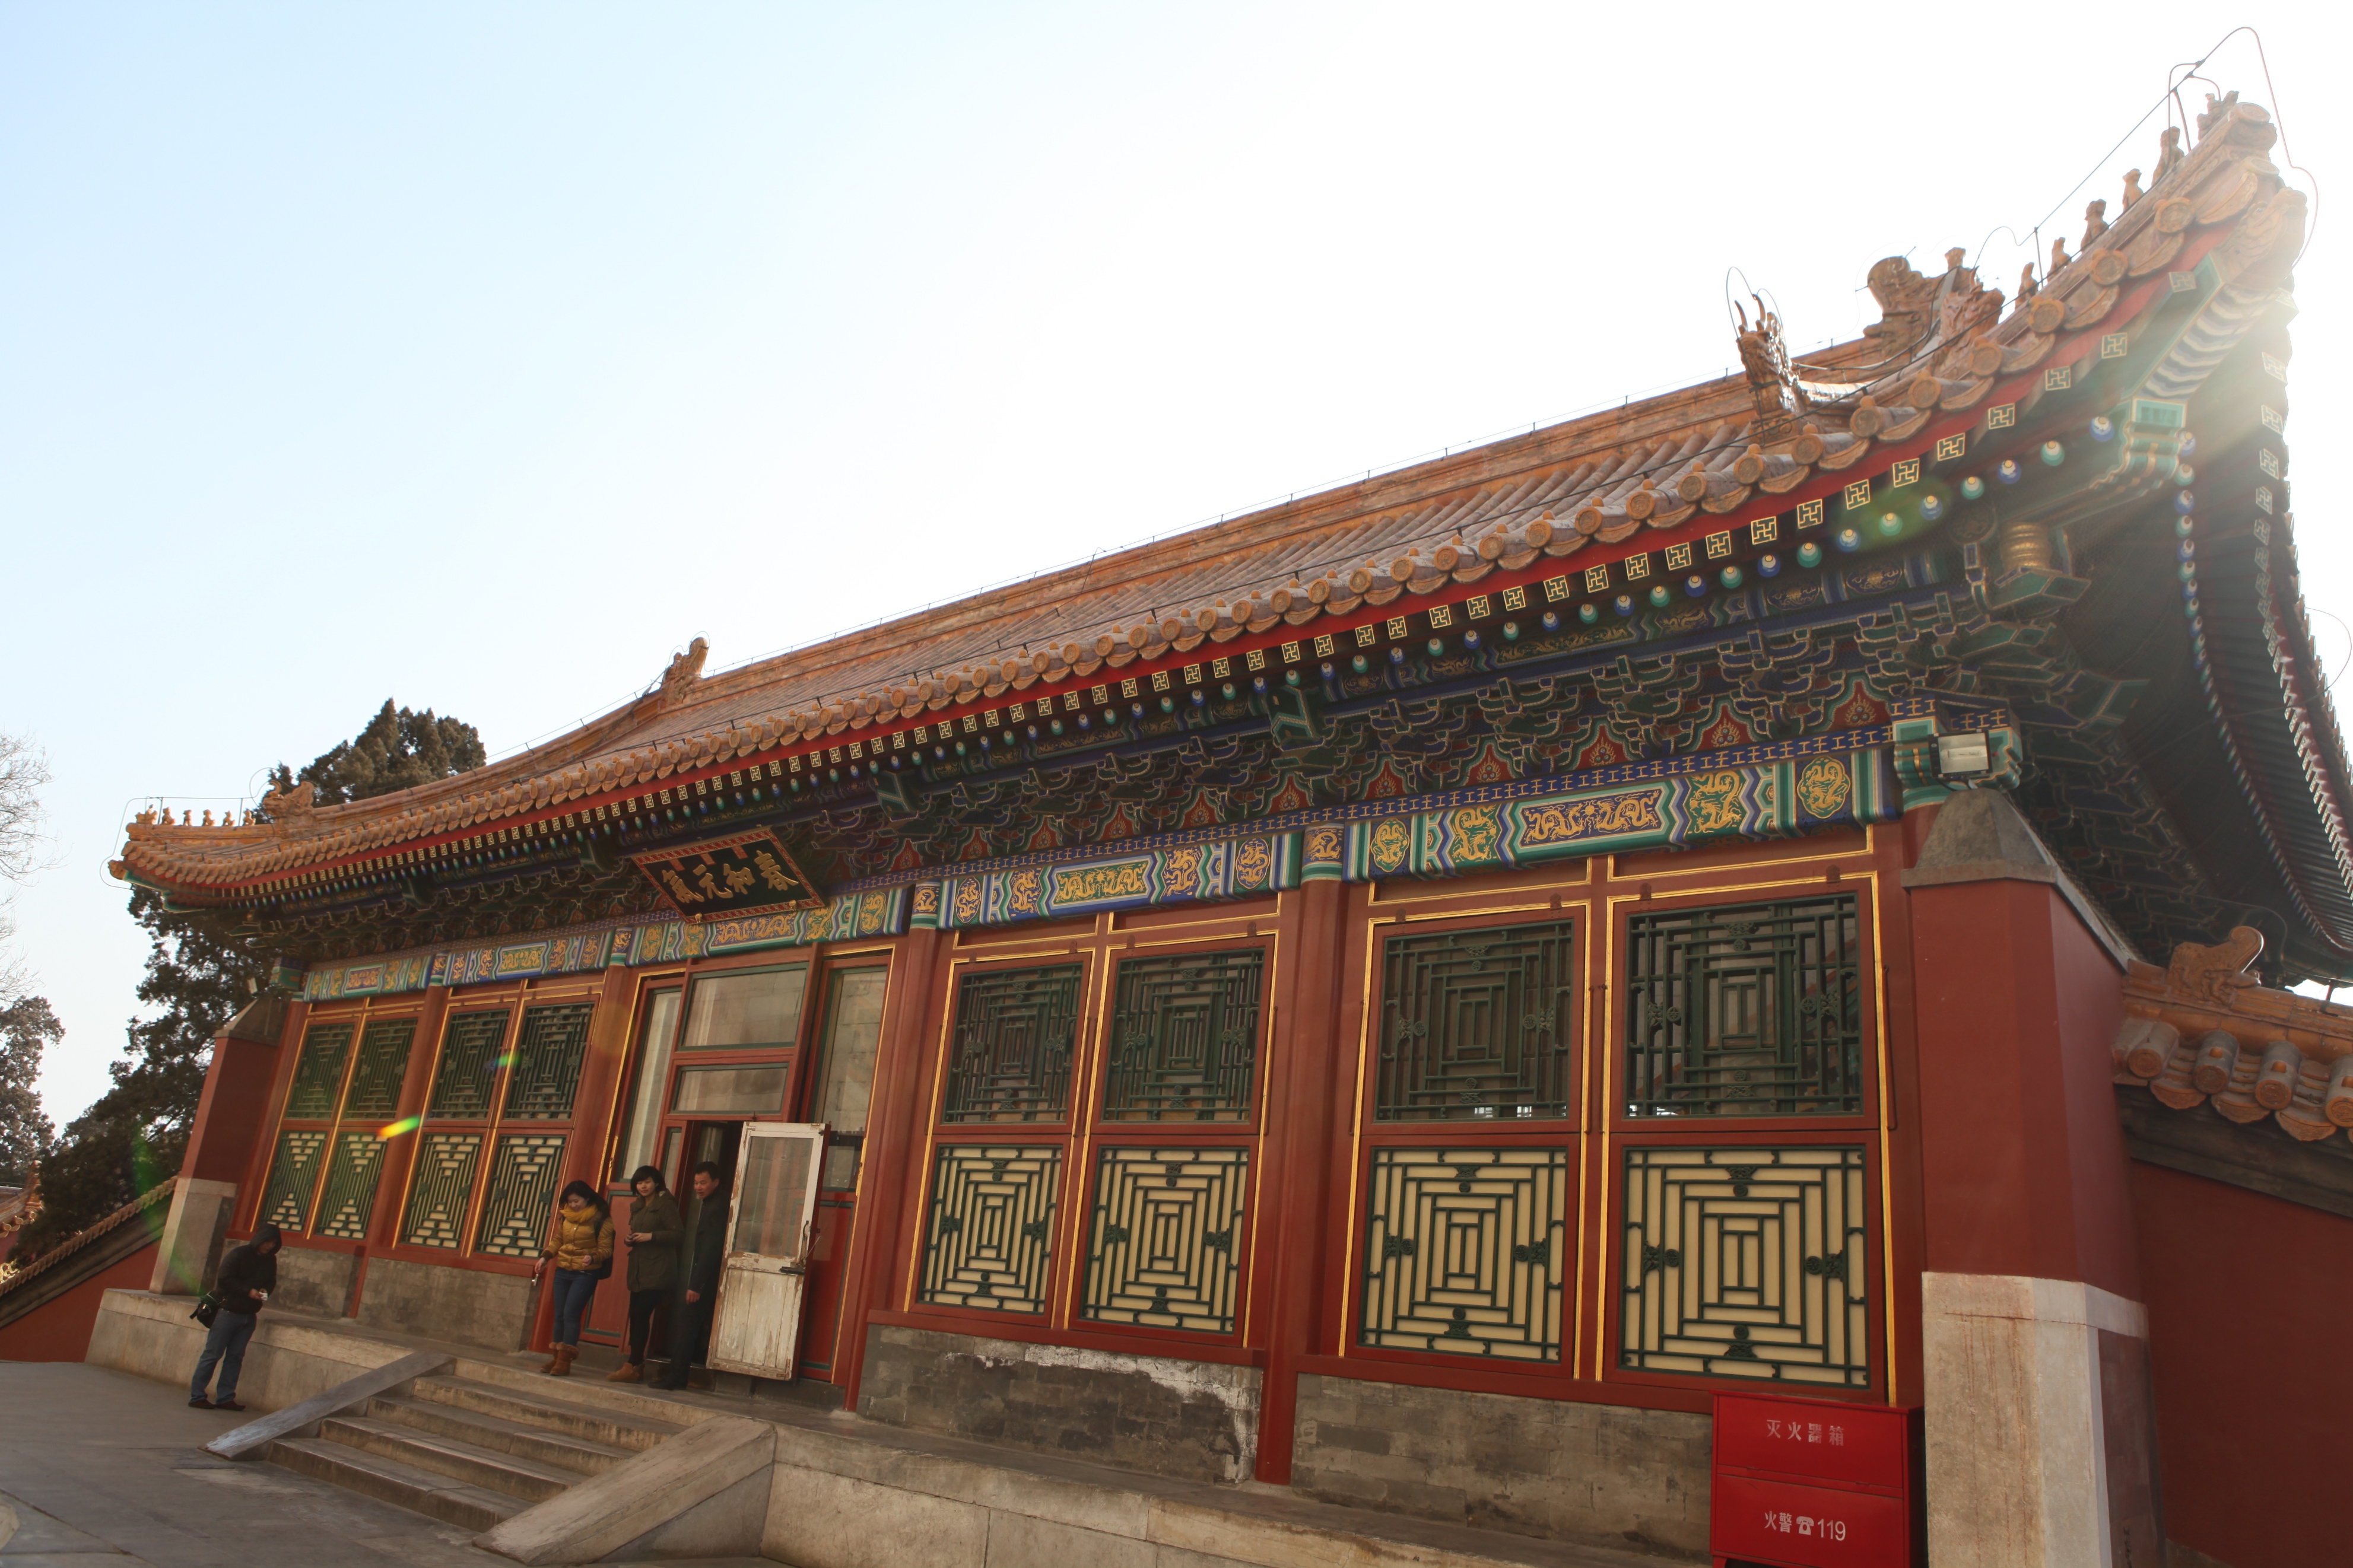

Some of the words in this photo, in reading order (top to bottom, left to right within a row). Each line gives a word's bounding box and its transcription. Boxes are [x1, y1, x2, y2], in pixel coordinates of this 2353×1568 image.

[1766, 1419, 1844, 1446] 灭火器箱
[1764, 1510, 1793, 1534] 火警
[1817, 1518, 1846, 1541] 119
